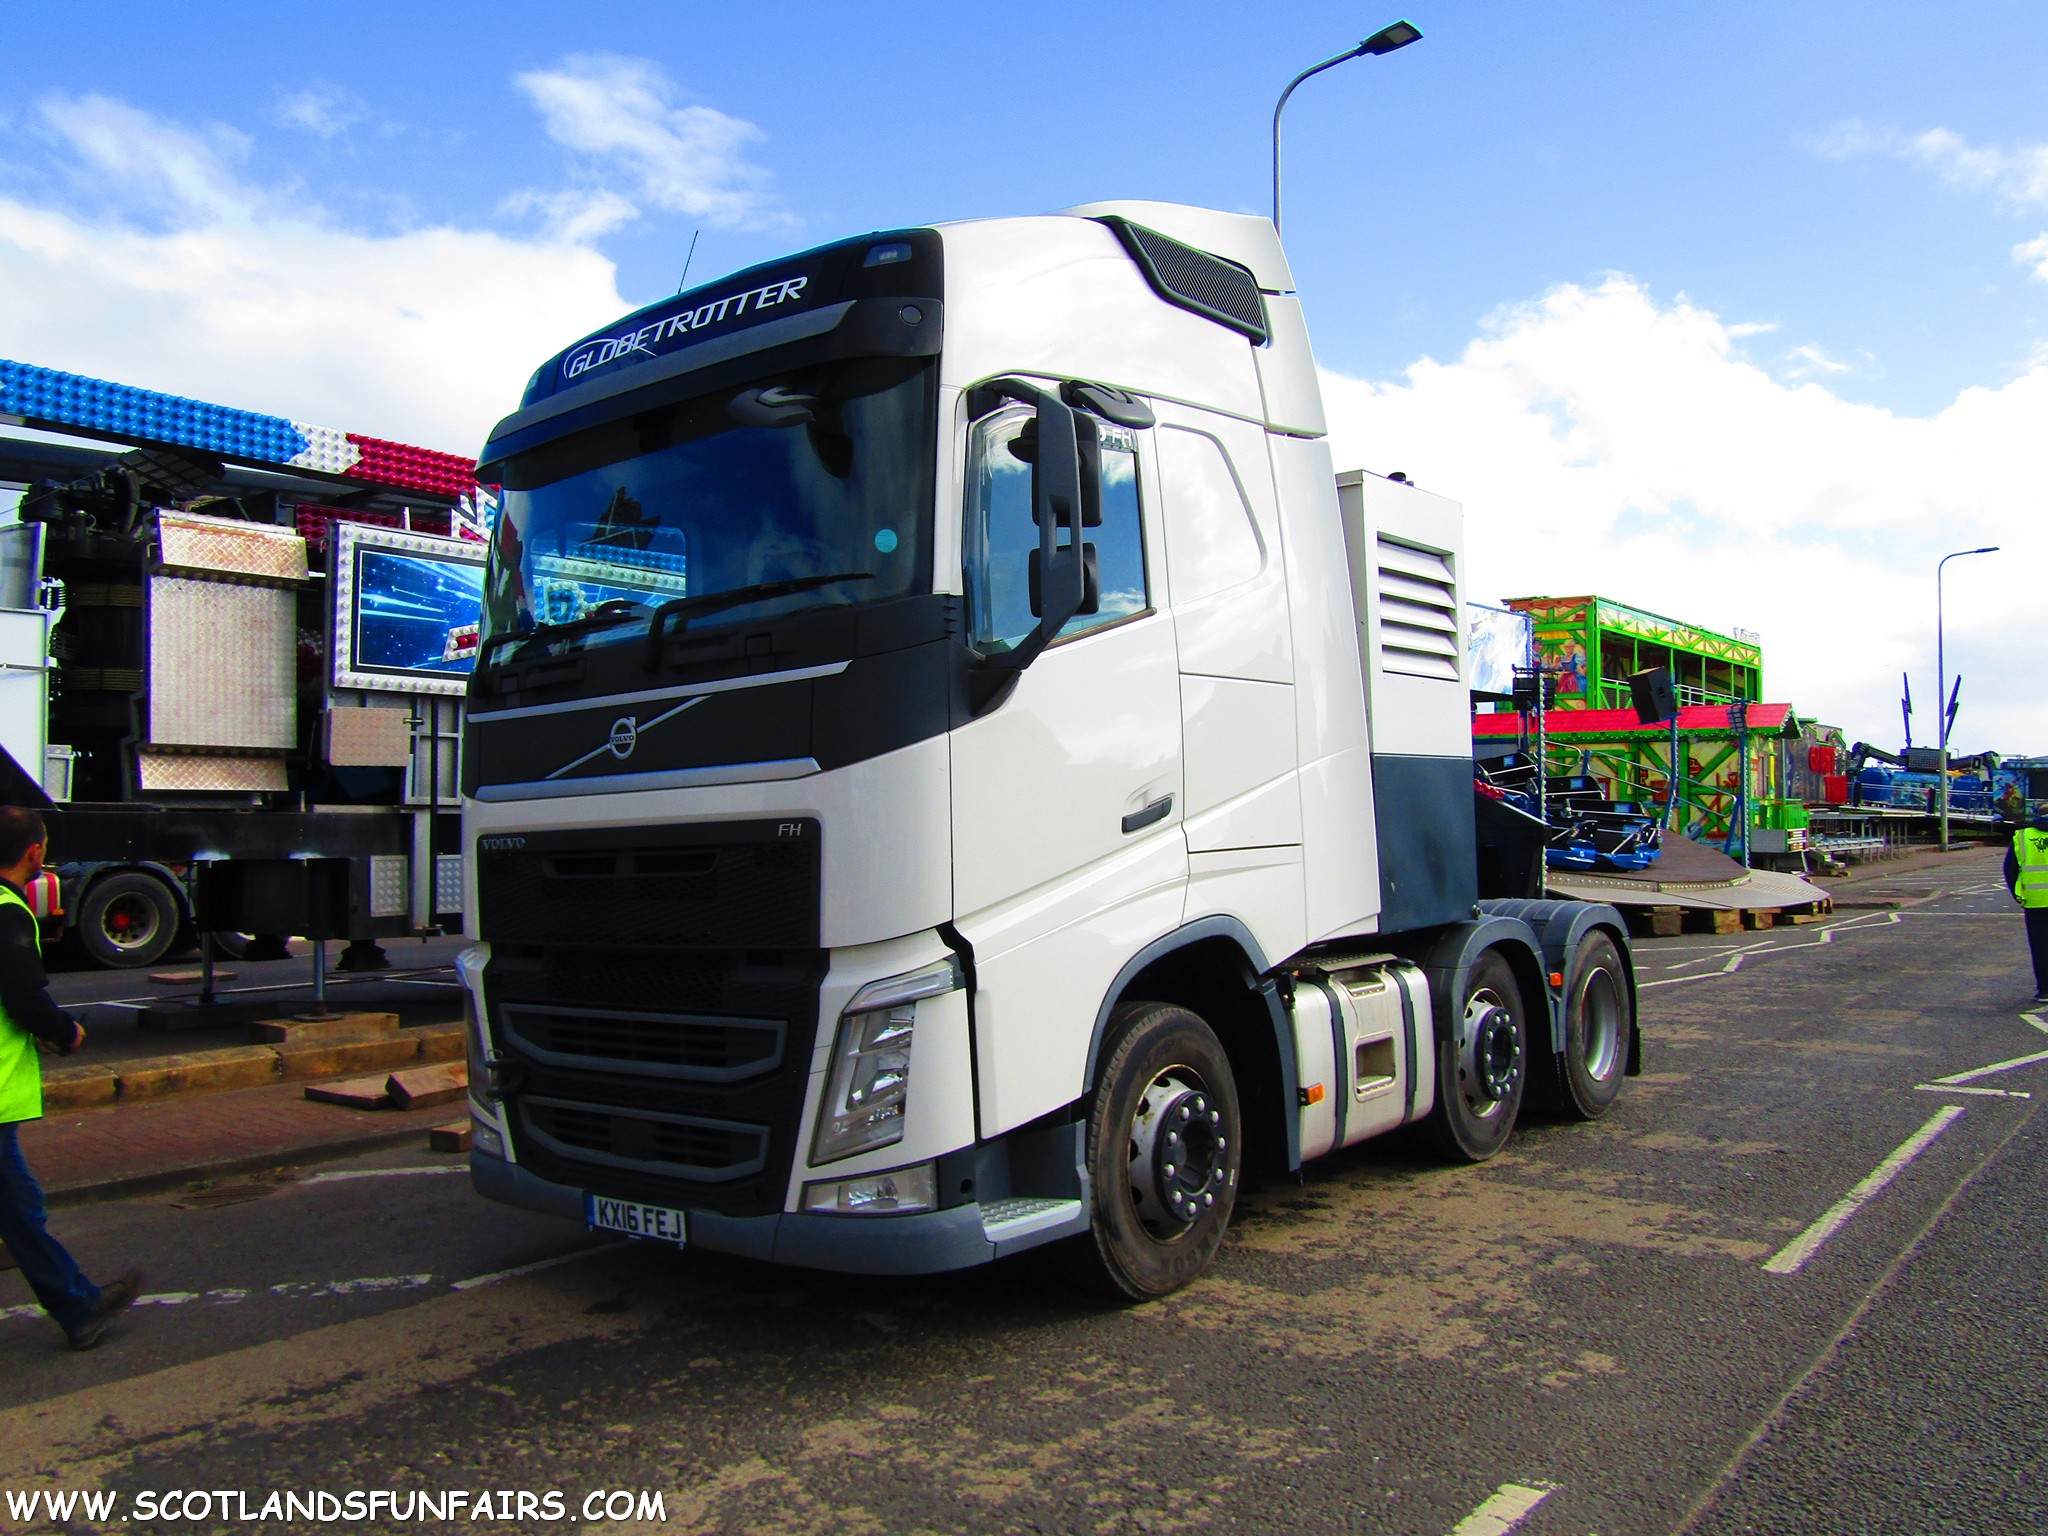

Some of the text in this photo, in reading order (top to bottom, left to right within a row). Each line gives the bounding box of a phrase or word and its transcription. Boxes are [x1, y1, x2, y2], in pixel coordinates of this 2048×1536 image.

[565, 277, 808, 379] GLOBETROTTER
[1111, 427, 1132, 448] FH
[611, 734, 635, 743] VOLVO
[778, 823, 802, 837] FH
[481, 837, 526, 850] VOLVO
[598, 1198, 682, 1239] KX16 FEJ
